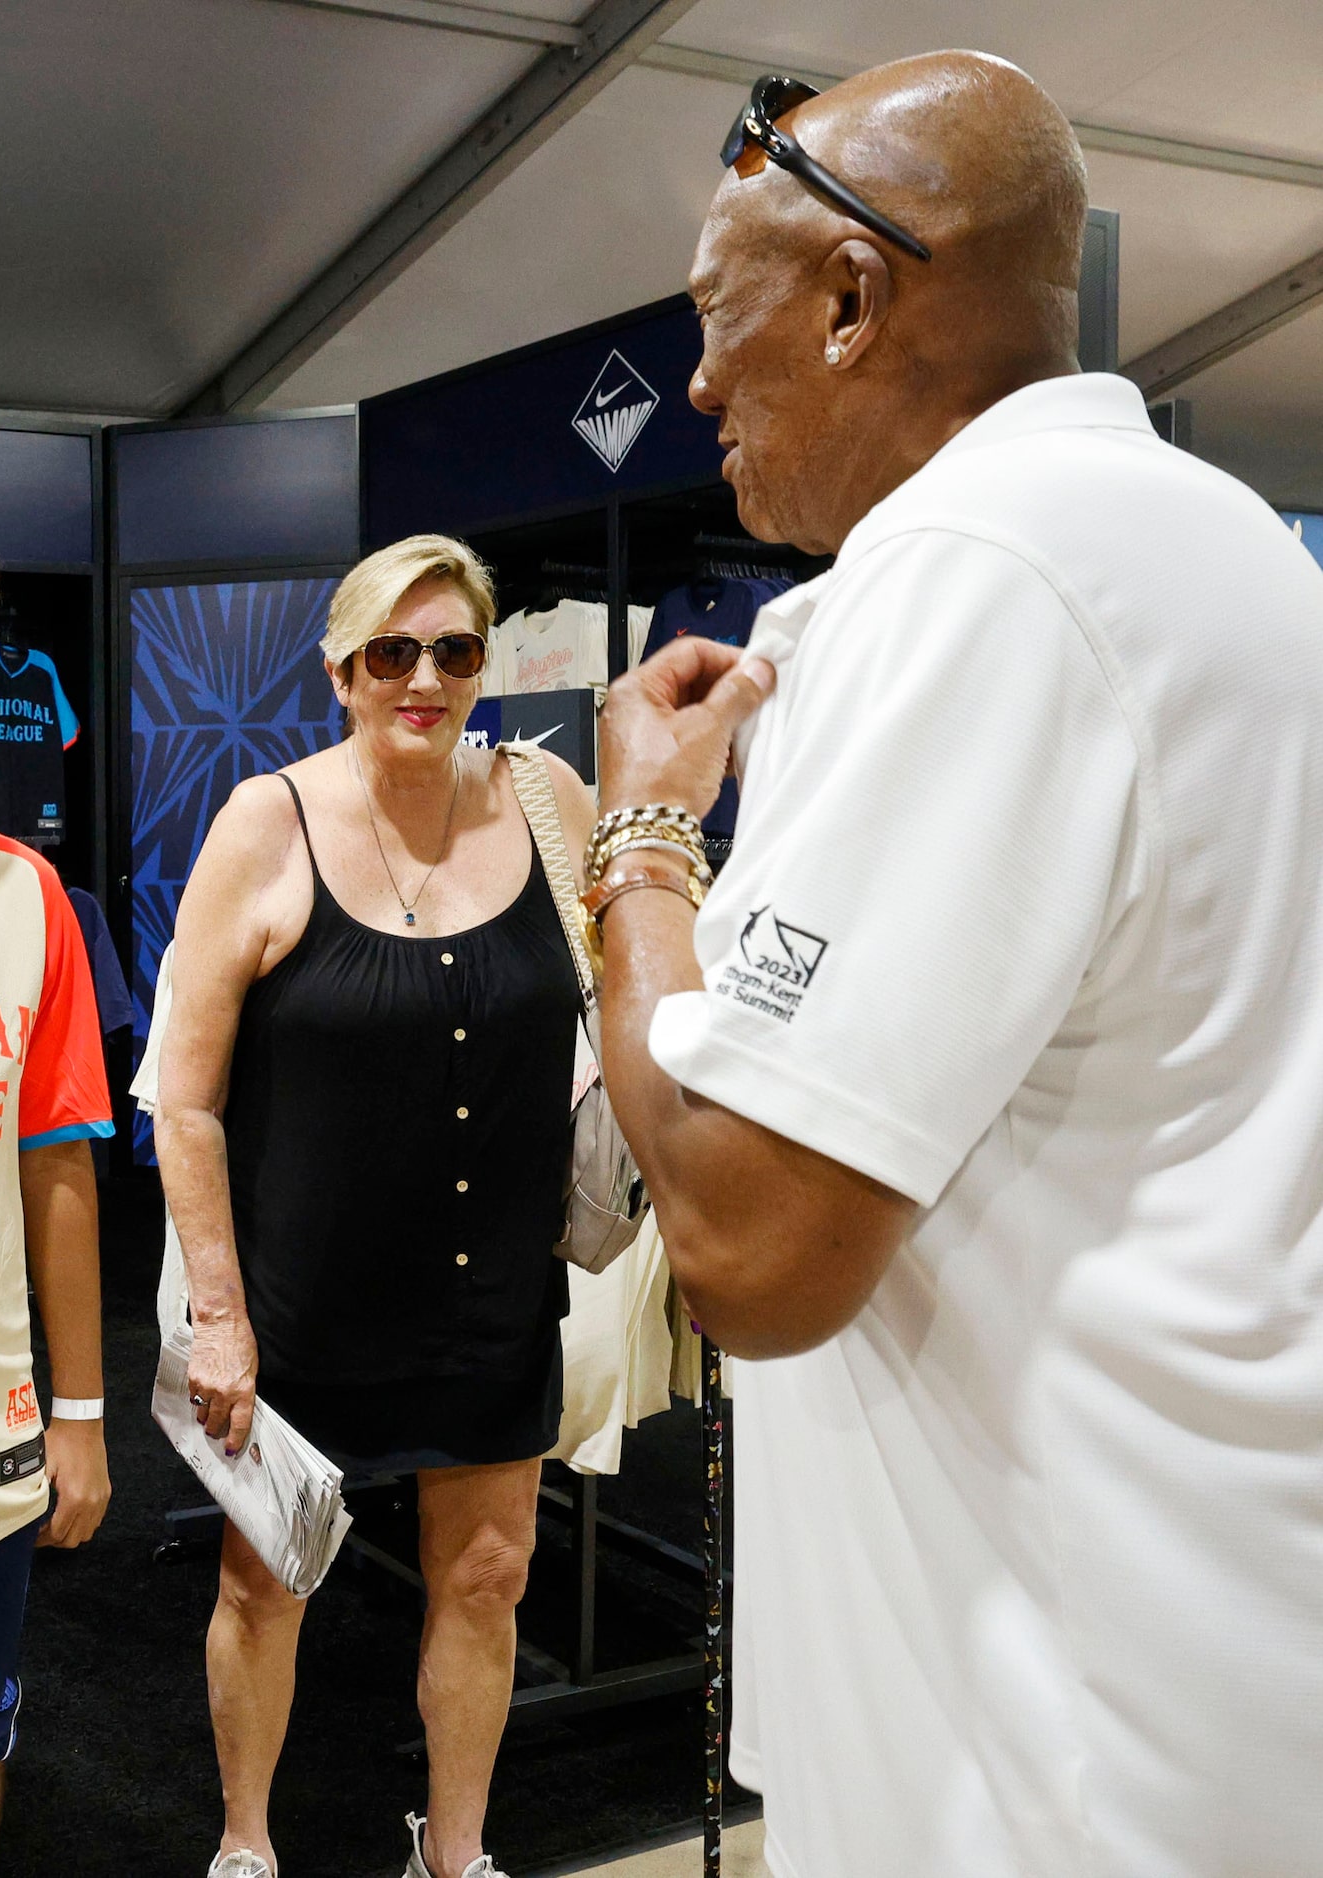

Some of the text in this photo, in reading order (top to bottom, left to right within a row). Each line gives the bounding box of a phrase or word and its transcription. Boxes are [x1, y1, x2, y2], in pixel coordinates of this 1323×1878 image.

[461, 729, 489, 750] EN'S
[755, 954, 802, 985] 2023
[733, 985, 795, 1023] Summit
